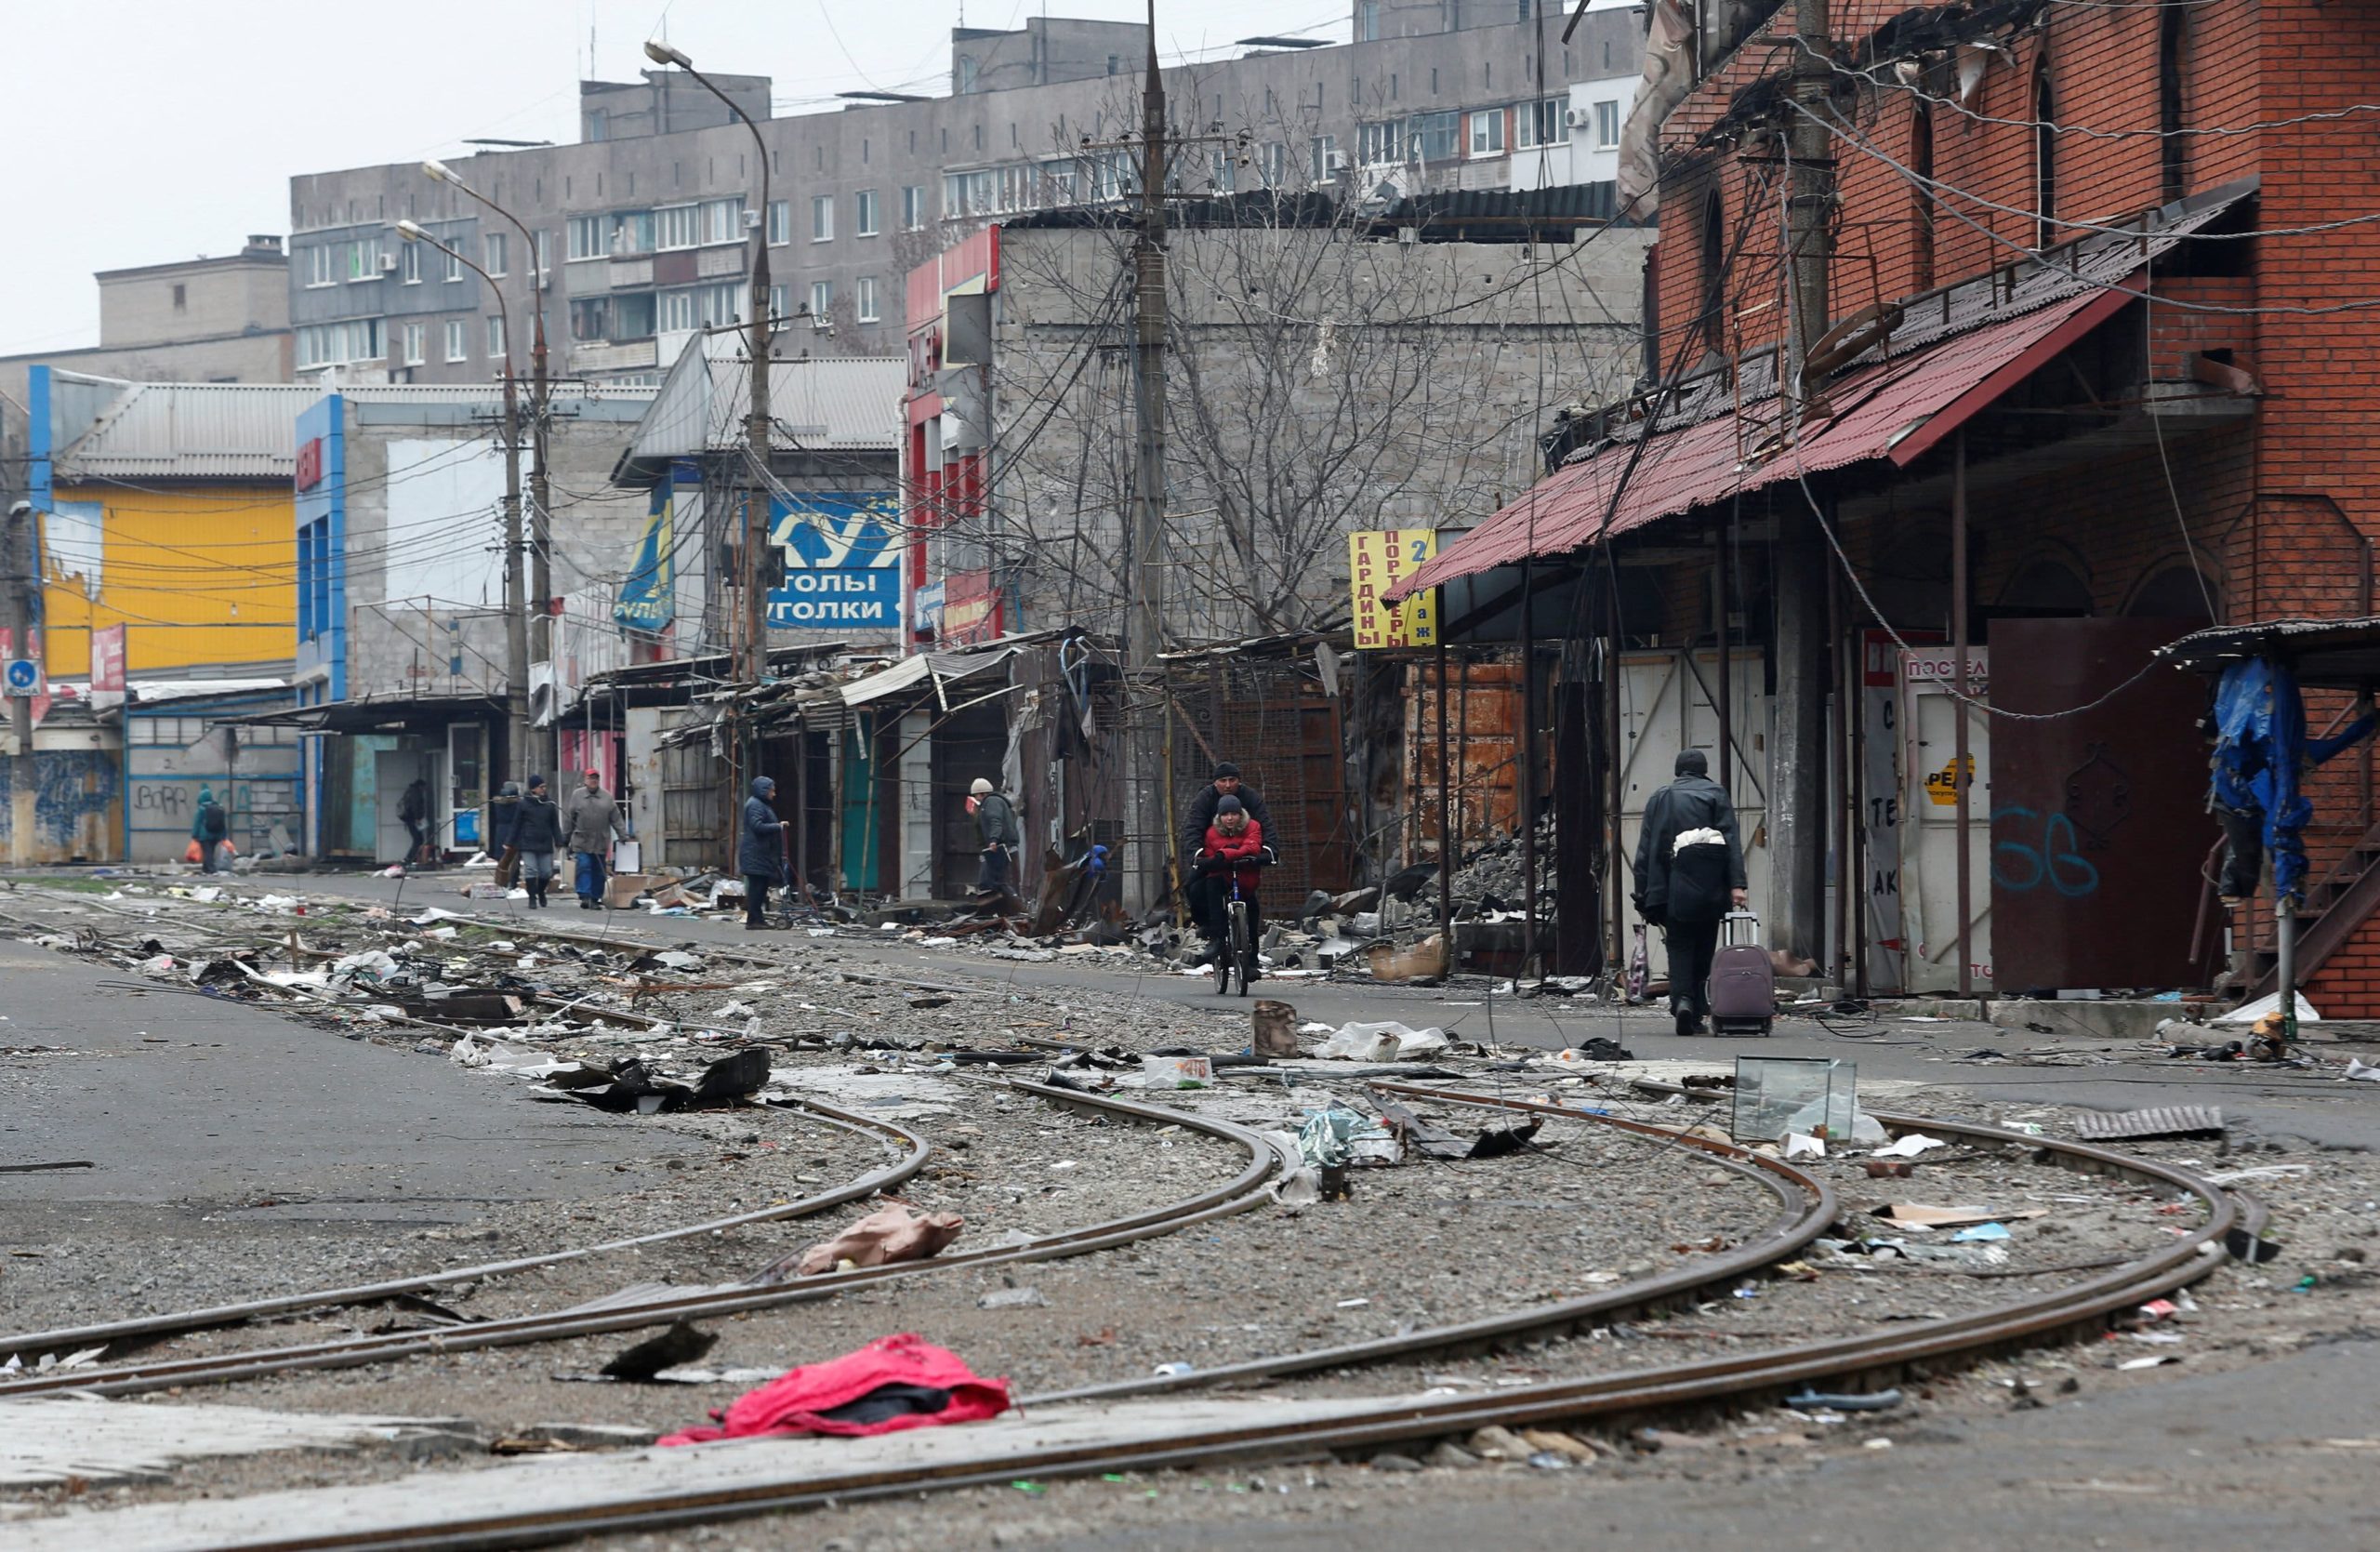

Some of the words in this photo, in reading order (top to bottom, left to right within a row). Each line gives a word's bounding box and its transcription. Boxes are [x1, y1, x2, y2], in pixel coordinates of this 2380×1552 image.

[1357, 537, 1380, 645] ГАРДИНЫ
[1384, 530, 1409, 647] ПОРТЕРЫ
[1411, 540, 1427, 562] 2
